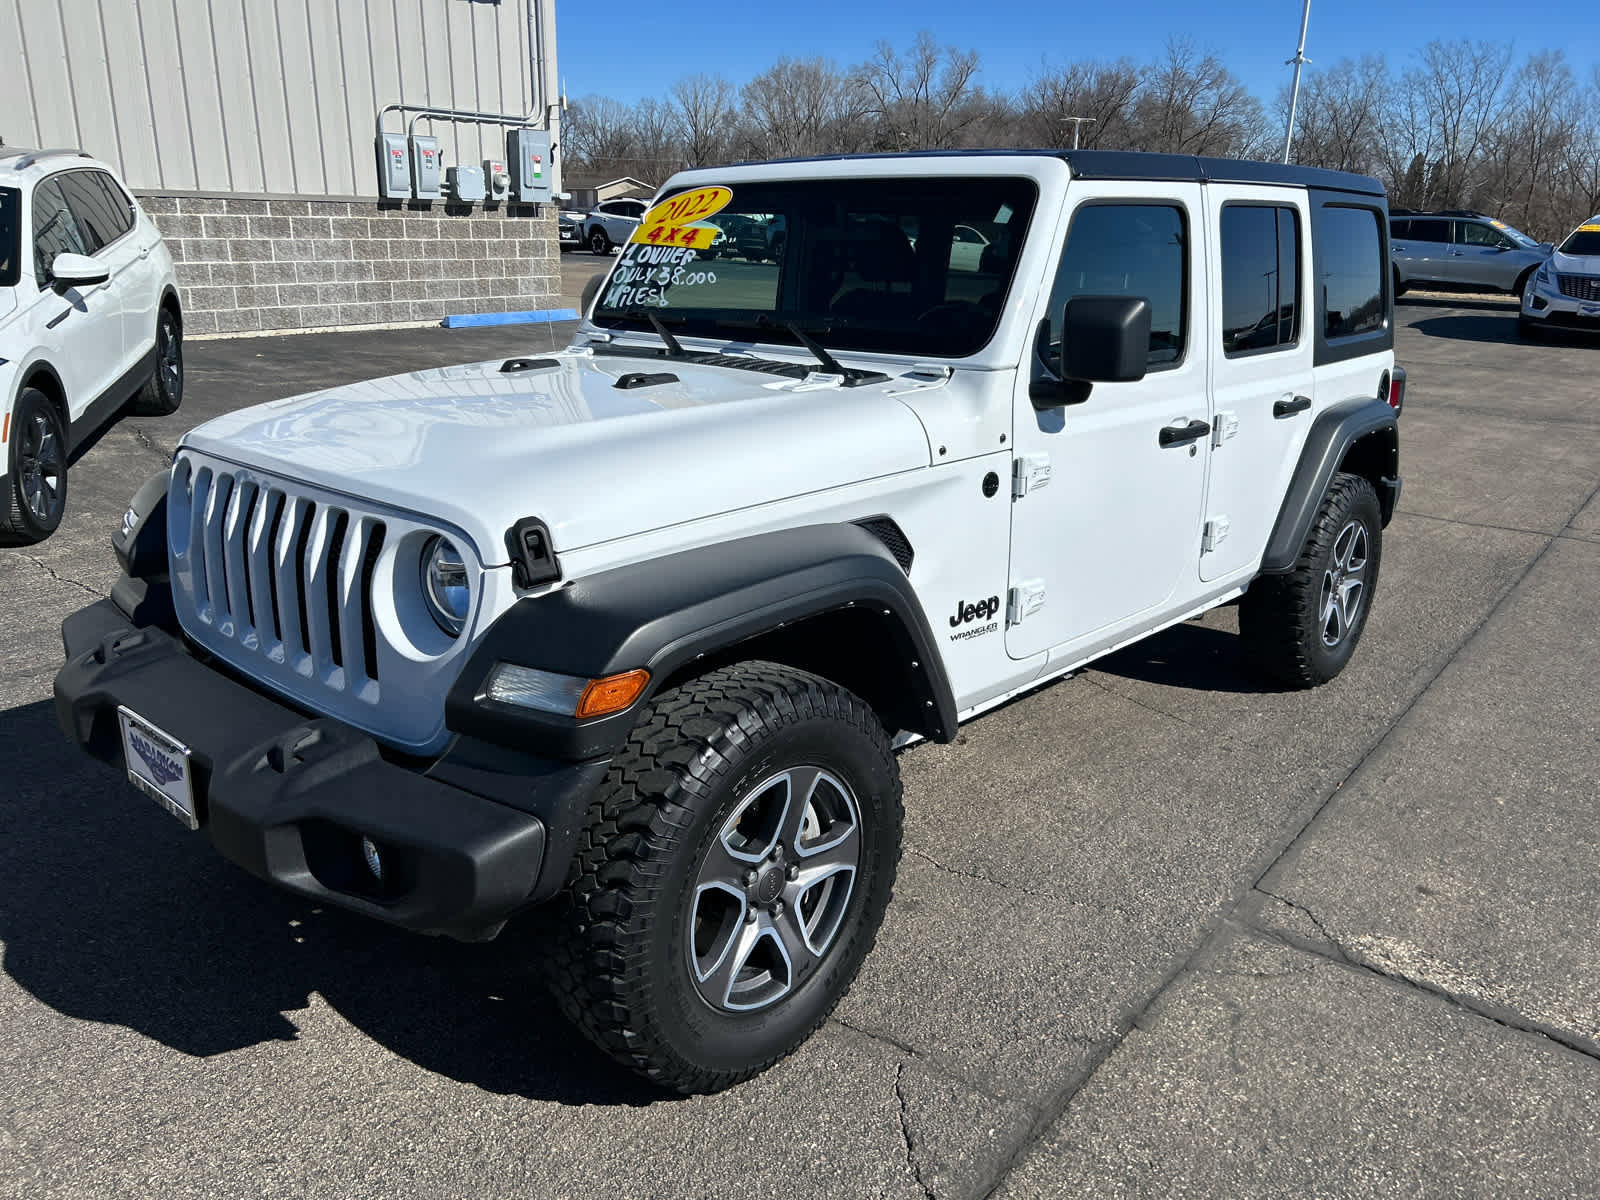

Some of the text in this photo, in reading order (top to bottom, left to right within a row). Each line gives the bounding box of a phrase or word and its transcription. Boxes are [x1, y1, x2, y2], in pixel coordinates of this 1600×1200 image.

[655, 190, 719, 224] 2022
[612, 265, 658, 284] ONLY
[949, 595, 1000, 628] Jeep
[950, 622, 998, 642] WRANGLER
